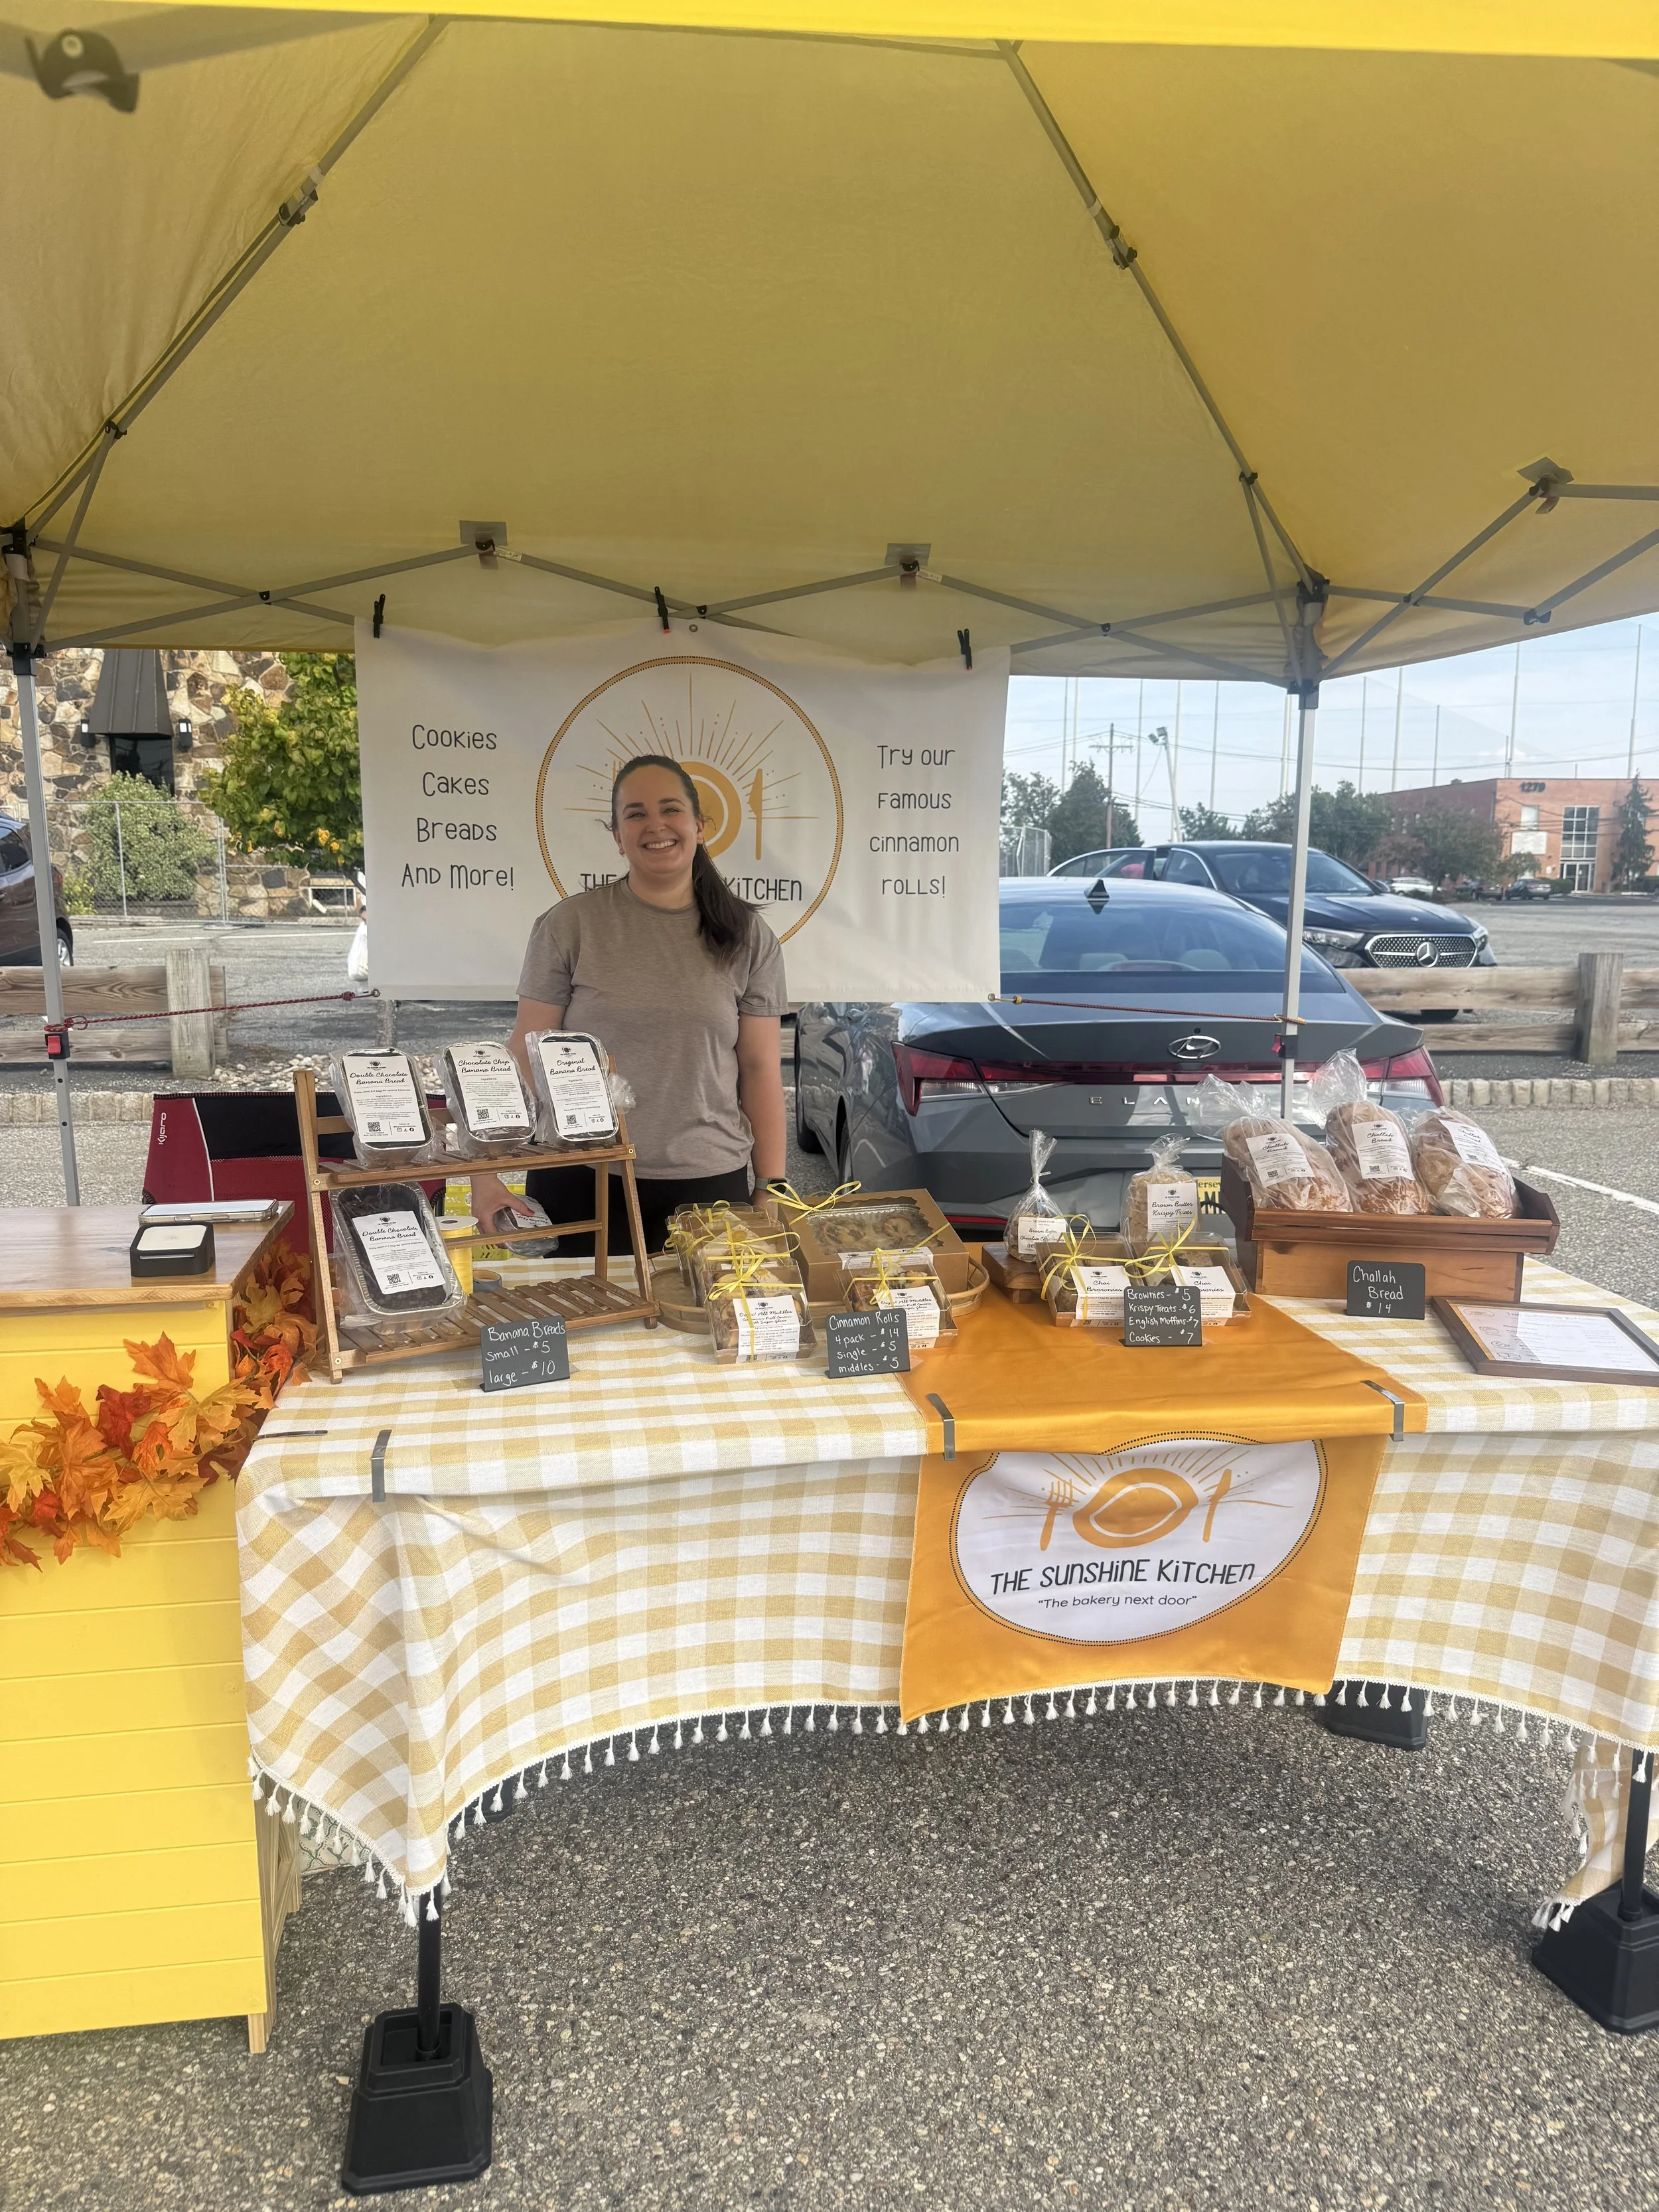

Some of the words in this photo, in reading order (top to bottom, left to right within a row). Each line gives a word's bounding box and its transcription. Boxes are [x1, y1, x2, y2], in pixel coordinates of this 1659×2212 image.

[412, 724, 497, 750] Cookies
[877, 745, 913, 769] Try
[921, 749, 956, 766] our
[422, 771, 490, 797] Cakes
[869, 836, 960, 852] cinnamon
[451, 864, 514, 891] More!
[557, 1057, 585, 1067] Original
[157, 1112, 168, 1145] Kijaro
[1353, 1266, 1396, 1284] Challah
[1127, 1288, 1165, 1299] Brownies
[1368, 1285, 1404, 1299] Bread
[1128, 1303, 1154, 1315] Krispy
[1155, 1304, 1177, 1313] Treats
[829, 1315, 871, 1331] Cinnamon
[875, 1311, 900, 1325] Rolls
[1129, 1316, 1159, 1329] English
[488, 1327, 530, 1341] Banana
[532, 1321, 566, 1338] Breads
[1129, 1331, 1161, 1343] Cookies
[835, 1335, 841, 1345] 4
[843, 1334, 865, 1348] pack
[485, 1345, 519, 1361] small
[837, 1347, 867, 1361] single
[838, 1363, 874, 1373] middles
[489, 1370, 518, 1386] large
[991, 1568, 1033, 1595] THE
[1072, 1595, 1120, 1607] bakery
[1124, 1595, 1155, 1605] next
